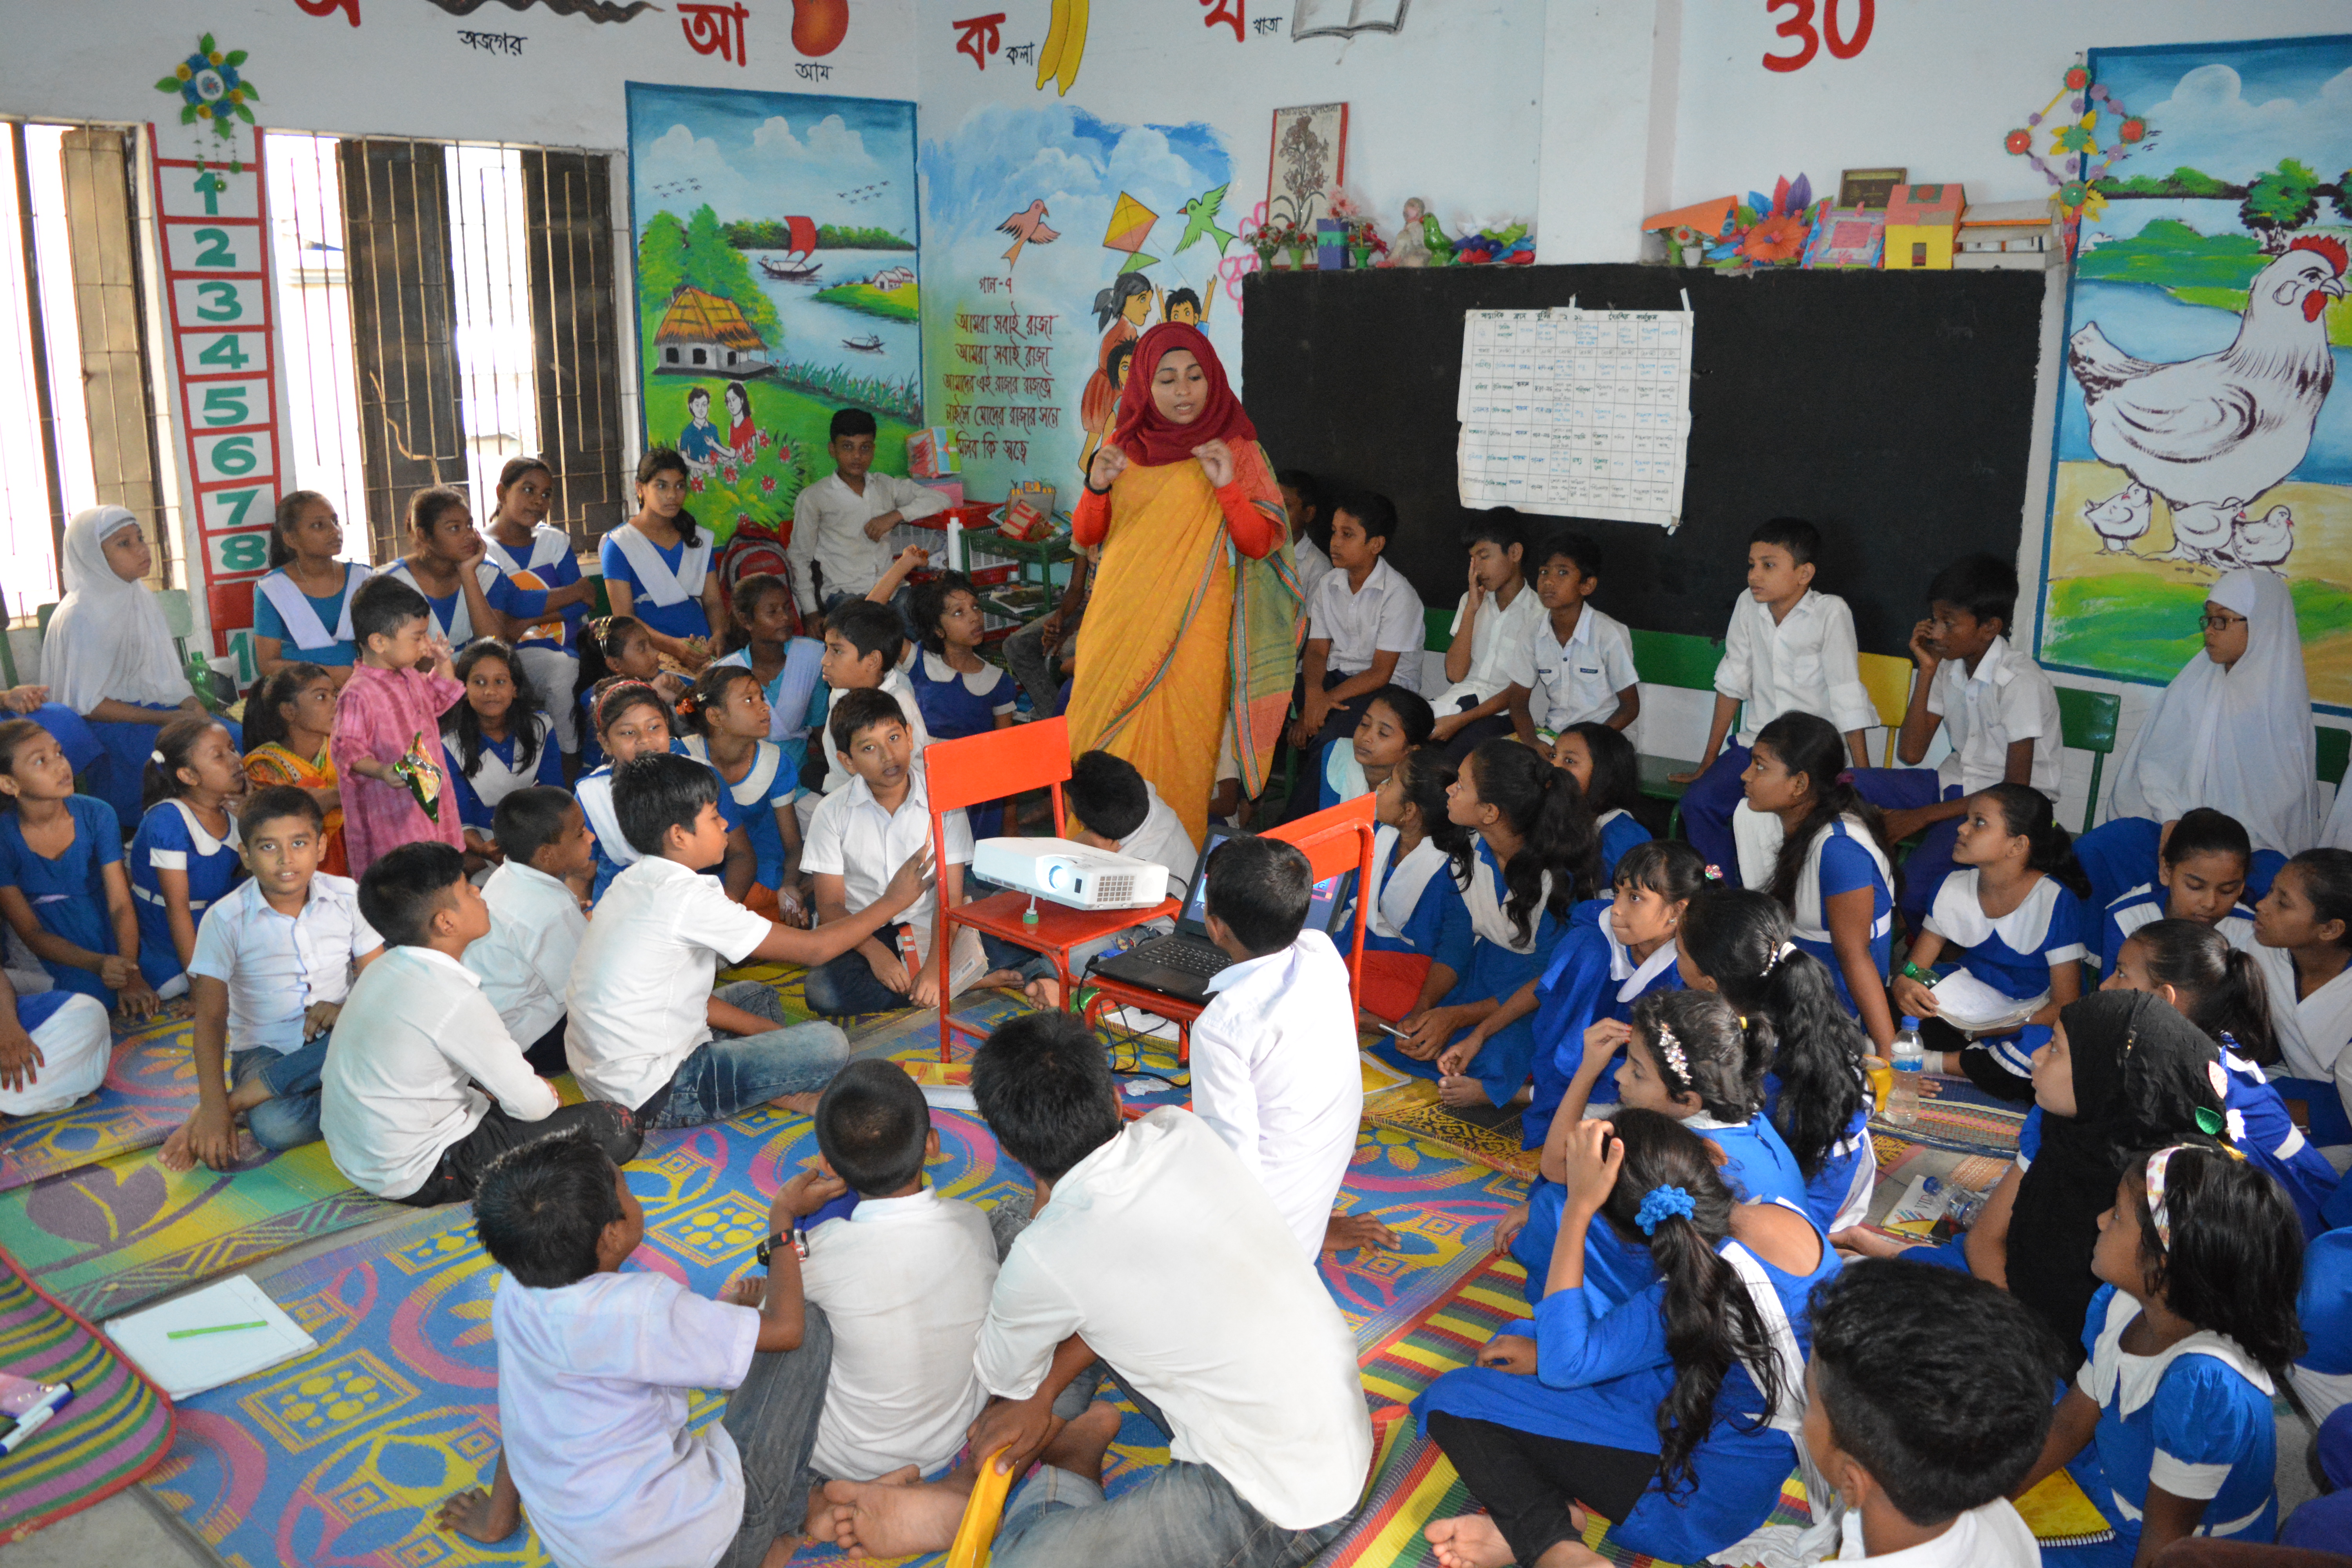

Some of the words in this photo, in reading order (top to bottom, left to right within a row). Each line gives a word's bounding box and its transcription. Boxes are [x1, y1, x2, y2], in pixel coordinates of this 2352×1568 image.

[457, 30, 528, 56] অজগর
[677, 2, 750, 67] আ
[952, 15, 1006, 71] ক
[1253, 17, 1283, 34] খাতা
[1762, 0, 1875, 72] 30
[795, 62, 833, 82] আম
[1005, 41, 1035, 66] কলা
[193, 172, 218, 215] 1
[194, 228, 236, 267] 2
[197, 281, 243, 321] 3
[955, 313, 991, 334] আমরা
[993, 301, 1027, 340] সবাই
[1026, 314, 1060, 341] রাজা
[198, 334, 249, 369] 4
[955, 343, 991, 366] আমরা
[994, 336, 1025, 372] সবাই
[1024, 346, 1054, 375] রাজা
[943, 374, 976, 395] আমাদের
[976, 366, 995, 396] এই
[995, 376, 1020, 400] রাজার
[203, 386, 249, 426] 5
[975, 406, 1007, 430] মোদের
[1009, 406, 1037, 435] রাজার
[1039, 407, 1061, 428] সনে
[212, 436, 257, 476] 6
[982, 431, 998, 459] কি
[216, 489, 259, 525] 7
[220, 535, 267, 571] 8
